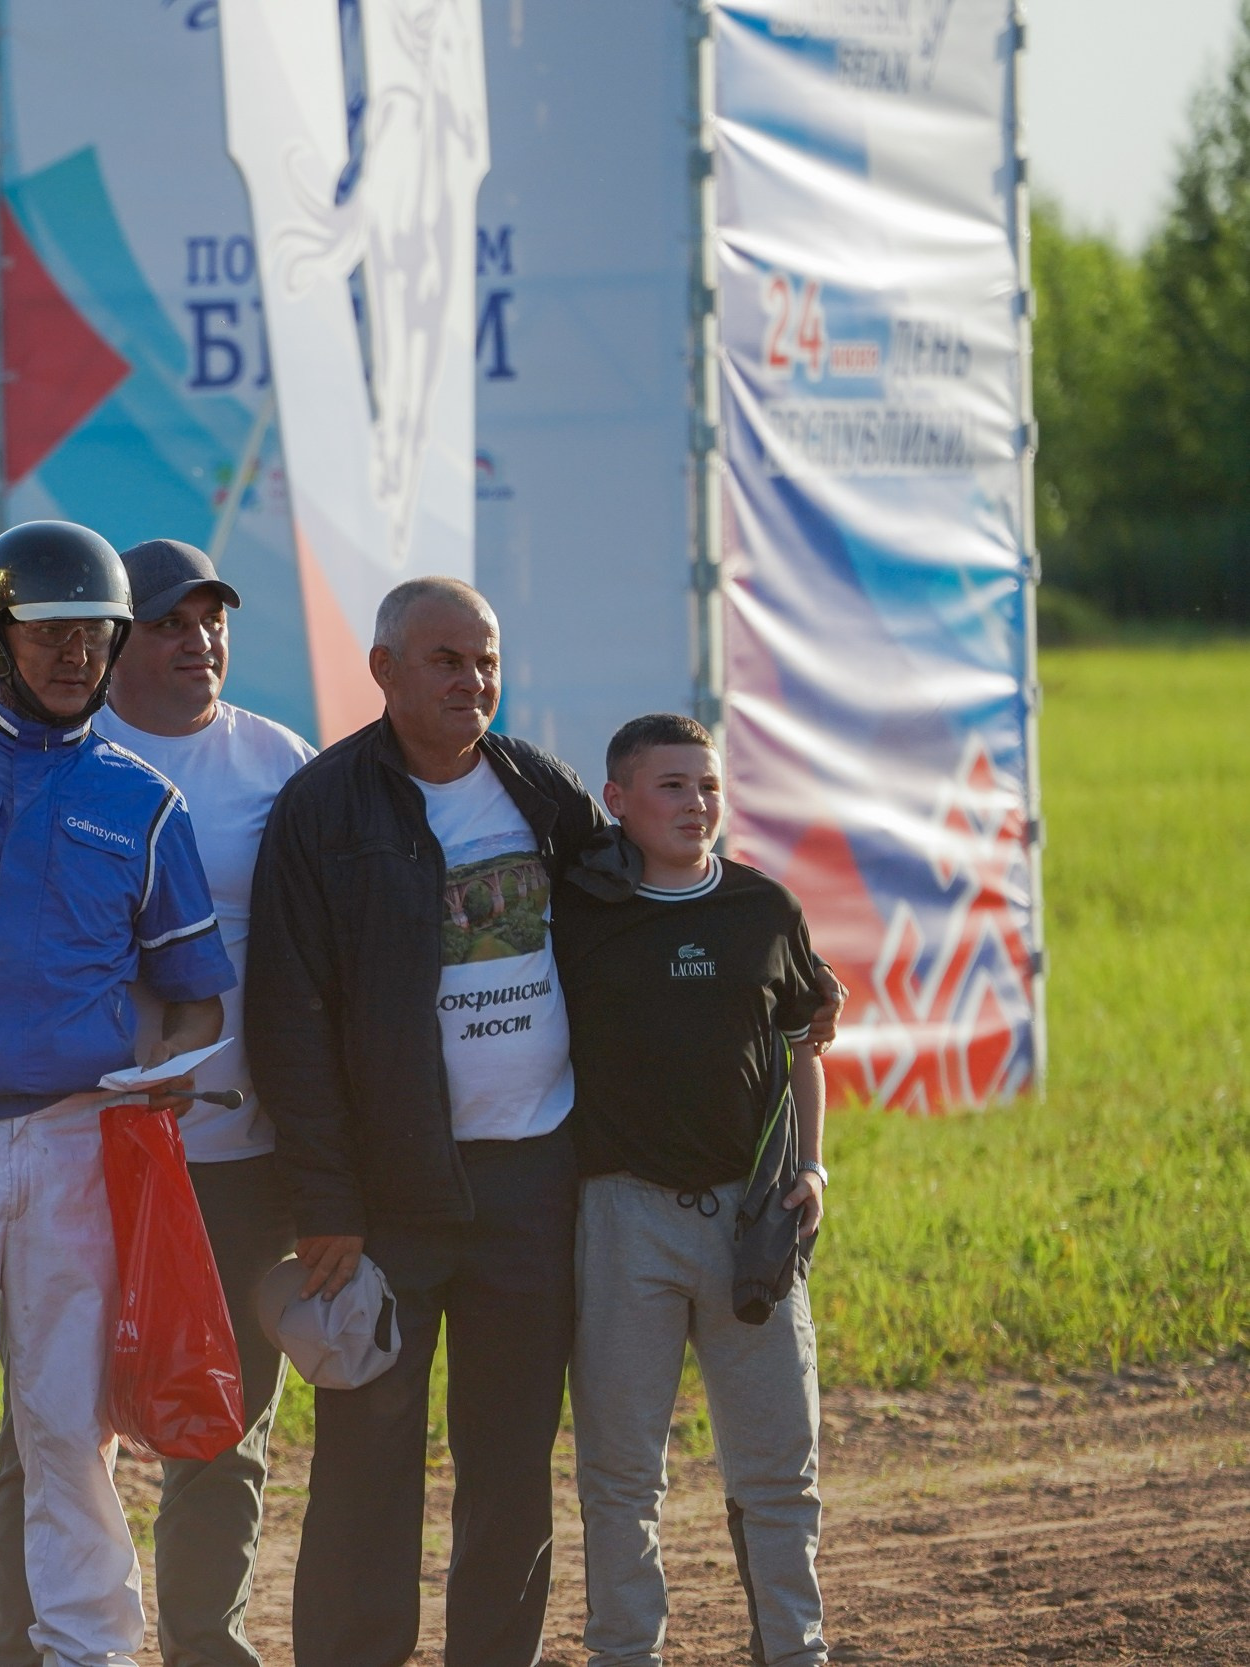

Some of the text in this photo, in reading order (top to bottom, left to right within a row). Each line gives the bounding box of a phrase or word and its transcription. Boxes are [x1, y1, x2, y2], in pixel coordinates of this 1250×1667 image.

[768, 277, 823, 371] 24
[66, 816, 130, 846] Galimzynov
[670, 961, 716, 977] LACOSTE
[460, 1014, 532, 1041] мост
